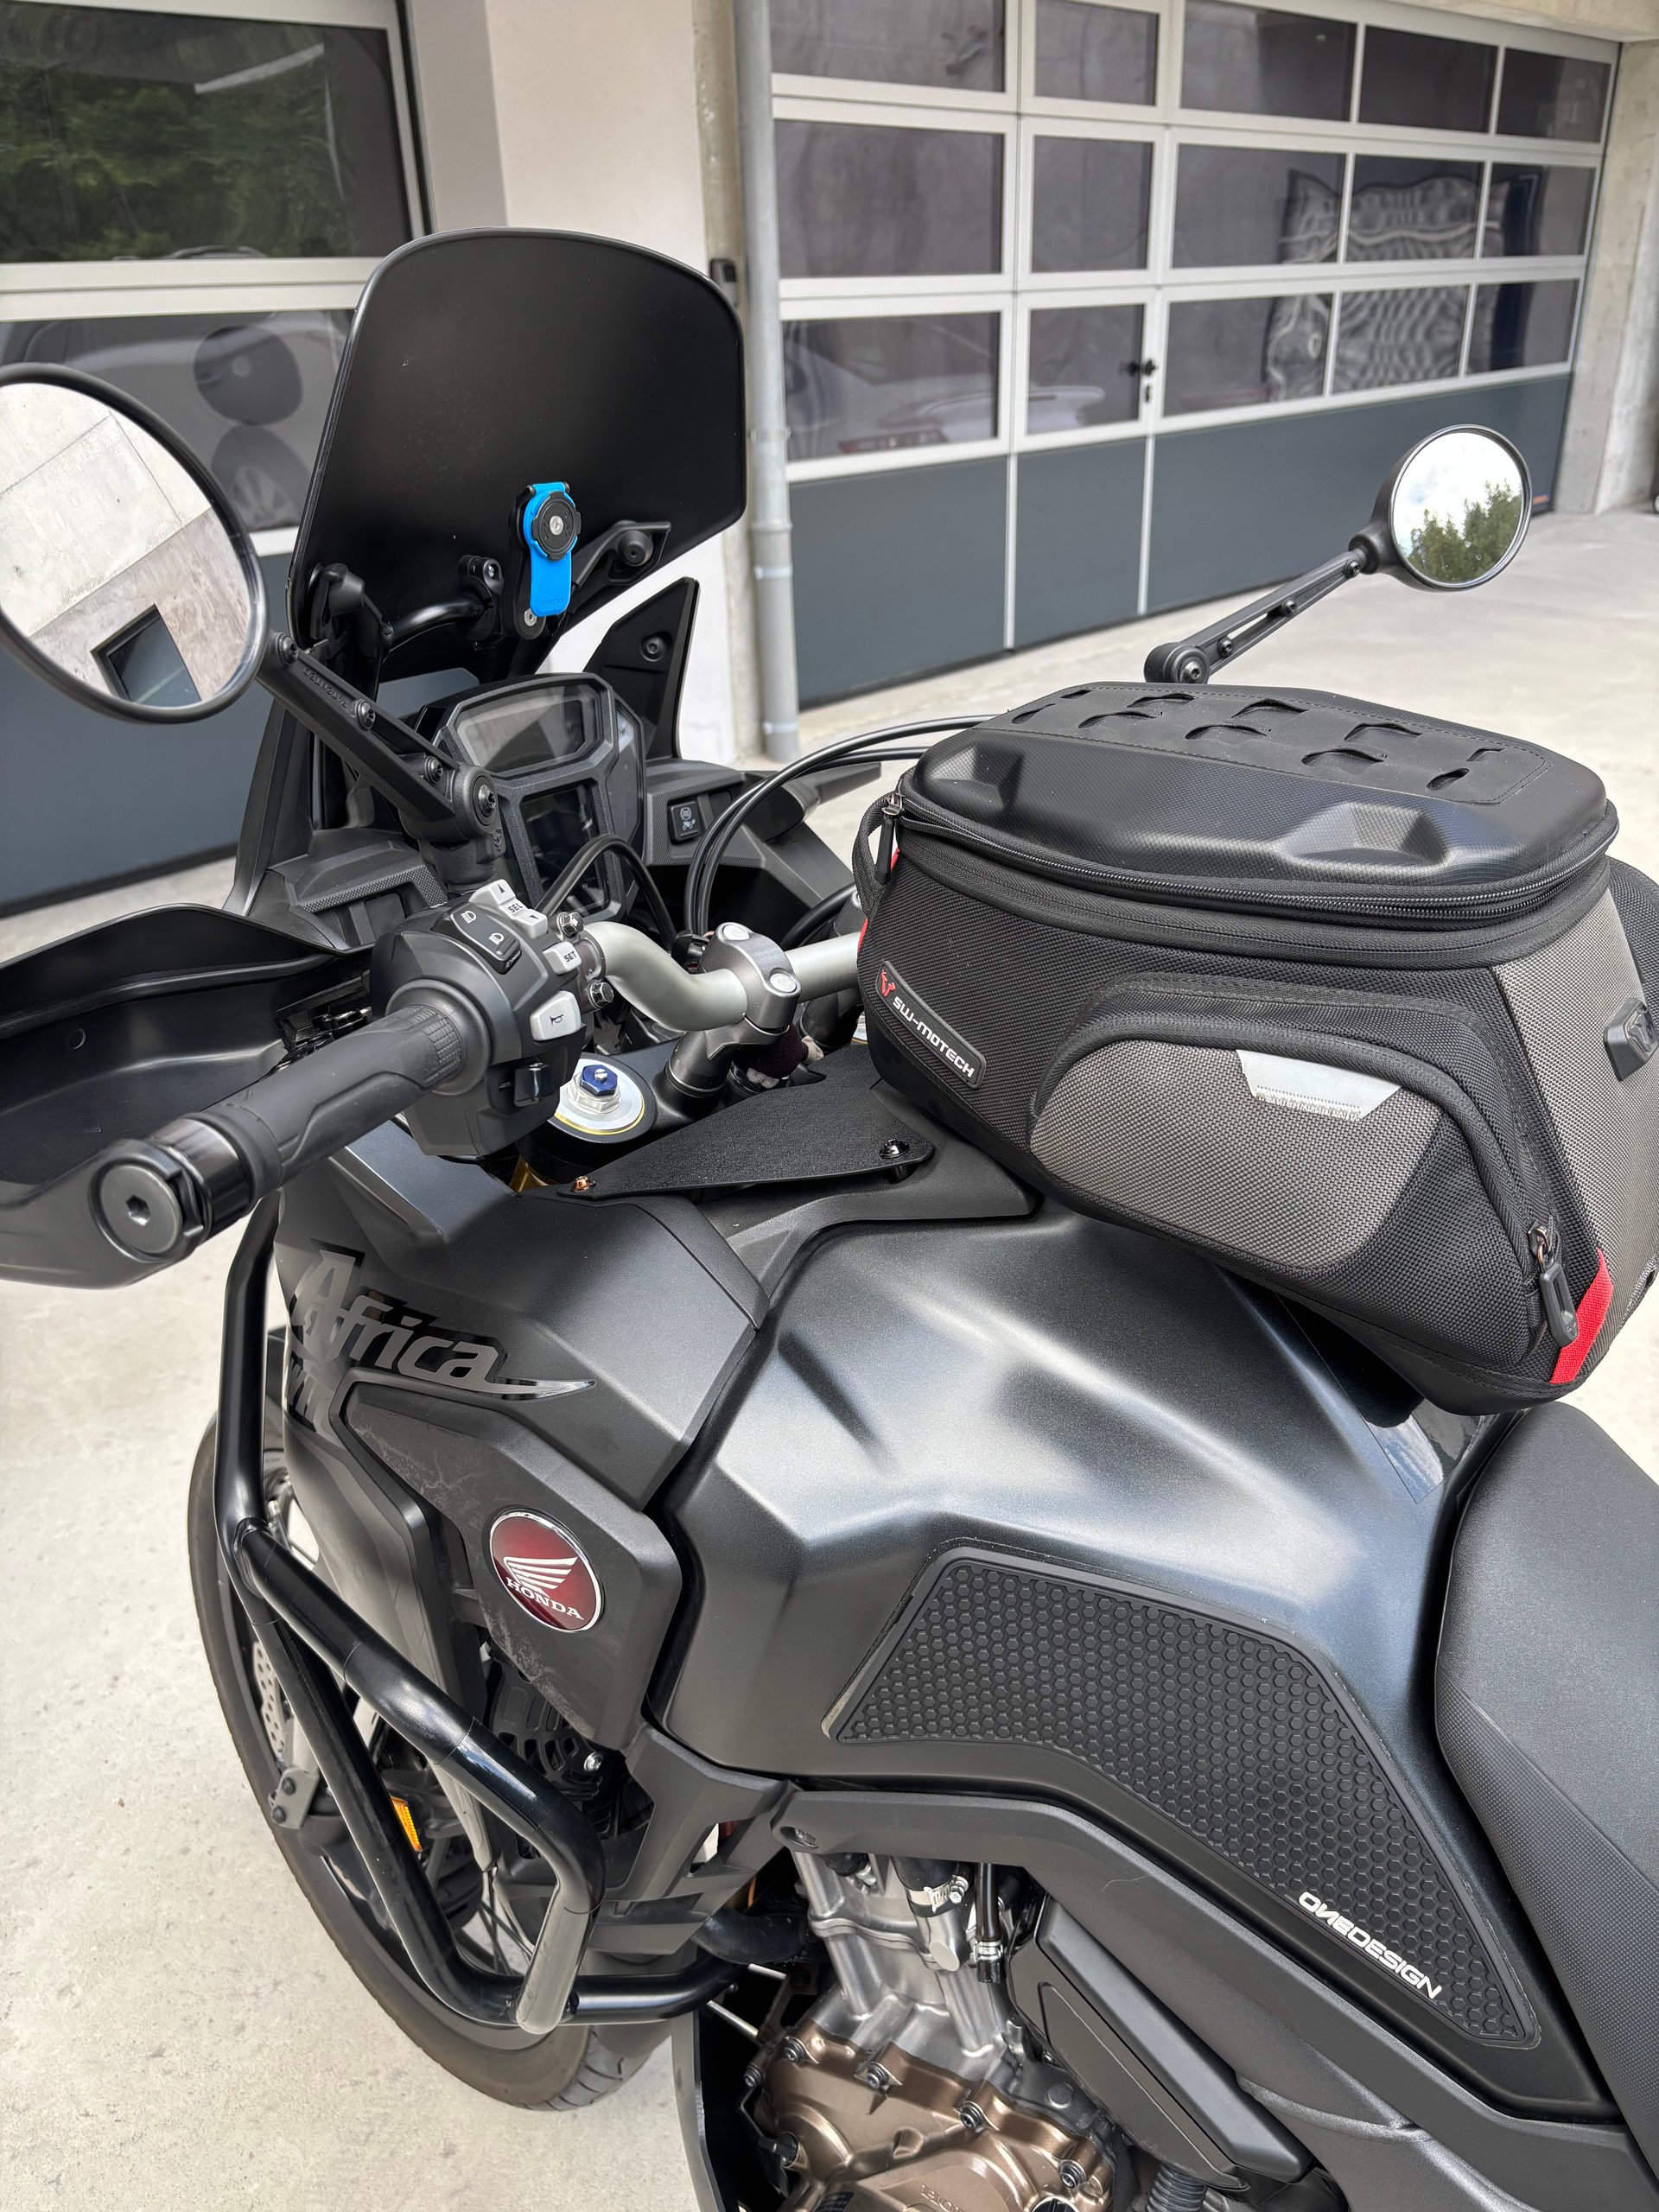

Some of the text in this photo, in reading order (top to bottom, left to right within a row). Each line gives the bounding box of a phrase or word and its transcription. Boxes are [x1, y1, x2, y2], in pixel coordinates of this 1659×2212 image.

[541, 596, 564, 607] PUSH
[303, 666, 348, 708] PATENTED
[507, 903, 524, 913] SEL
[563, 950, 577, 963] SET
[892, 995, 976, 1078] SW-MOTECH
[292, 1241, 596, 1398] Africa
[505, 1577, 585, 1620] HONDA
[1298, 1891, 1443, 1999] ONEDESIGN
